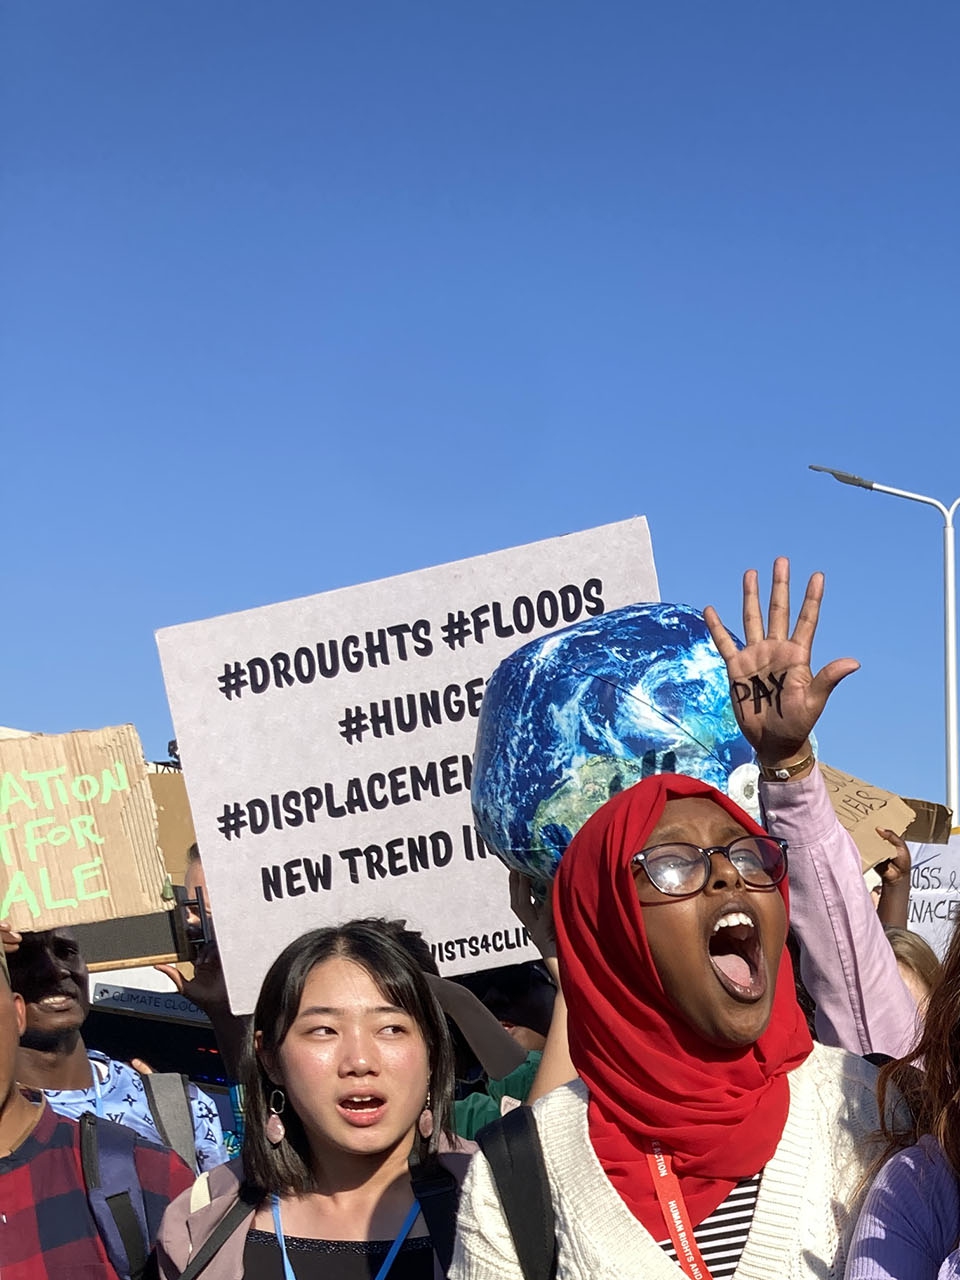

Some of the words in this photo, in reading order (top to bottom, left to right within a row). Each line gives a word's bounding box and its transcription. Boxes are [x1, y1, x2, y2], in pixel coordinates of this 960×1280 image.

[217, 618, 433, 701] #DROUGHTS
[440, 578, 605, 651] #FLOODS
[338, 677, 491, 745] #HUNGE
[732, 671, 788, 721] PAY
[24, 815, 105, 862] FOR
[261, 854, 332, 902] NEW
[340, 830, 453, 884] TREND
[911, 866, 942, 891] OSS
[112, 991, 161, 1008] CLIMATE
[668, 1200, 684, 1233] HUMAN
[677, 1231, 695, 1263] RIGHTS
[689, 1262, 703, 1280] AND
